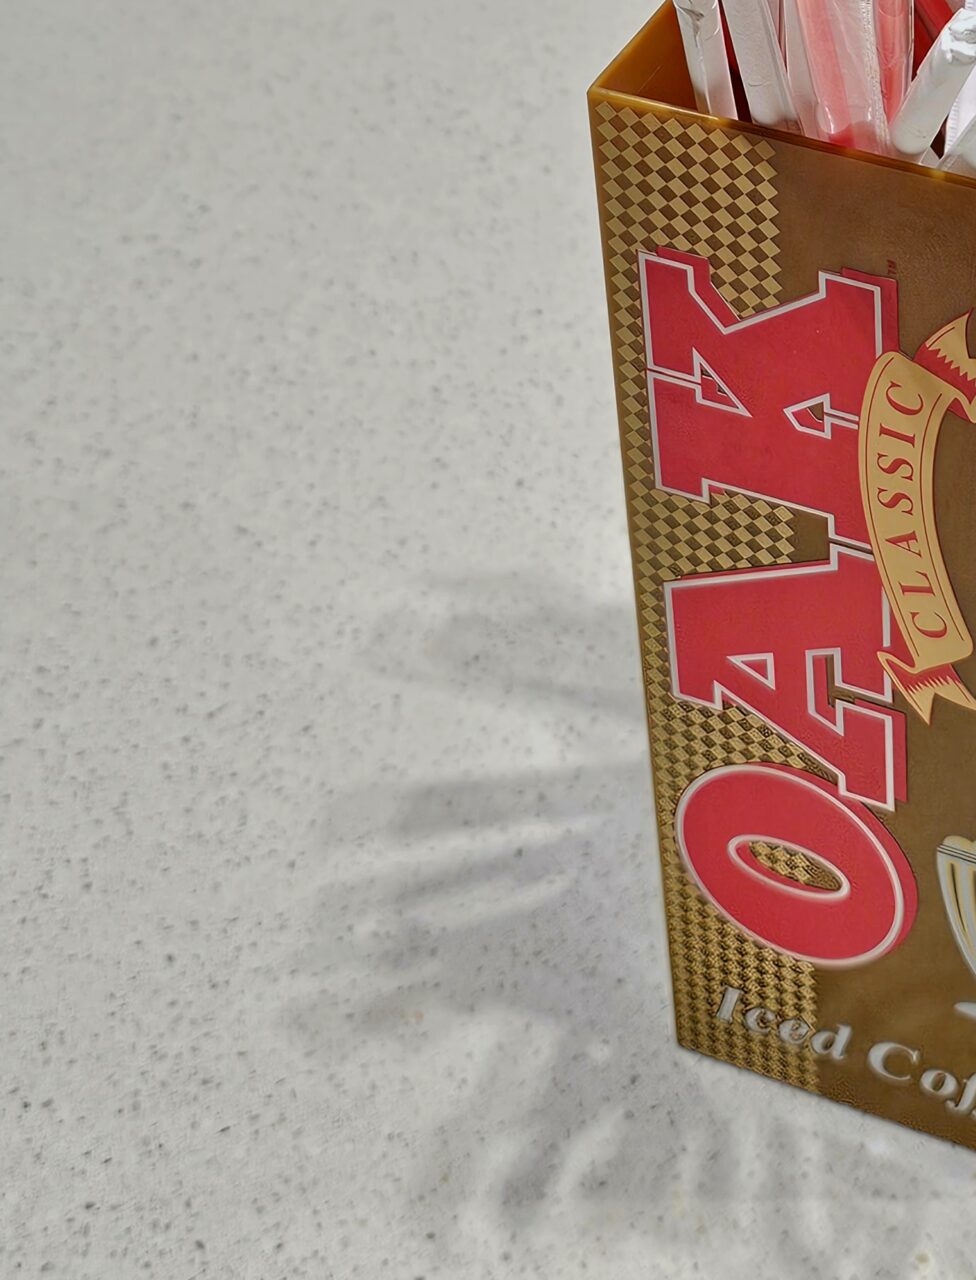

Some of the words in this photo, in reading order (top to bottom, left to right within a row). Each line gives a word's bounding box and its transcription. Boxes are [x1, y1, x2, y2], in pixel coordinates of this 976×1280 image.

[638, 247, 918, 968] OAK
[877, 380, 949, 639] CLASSIC
[714, 985, 853, 1062] Iced
